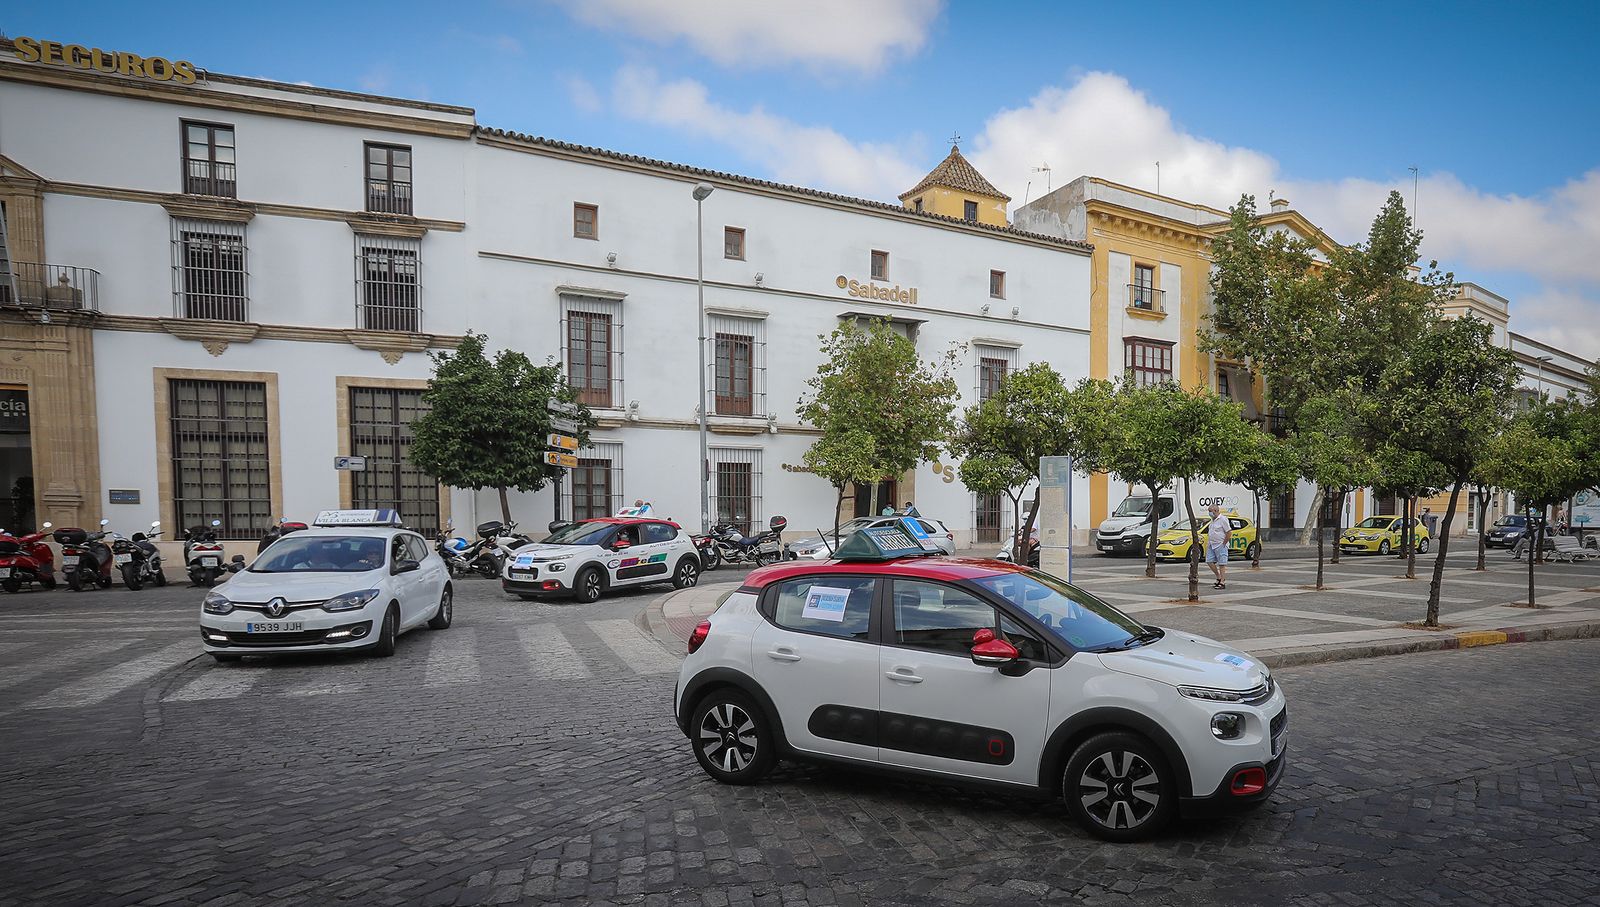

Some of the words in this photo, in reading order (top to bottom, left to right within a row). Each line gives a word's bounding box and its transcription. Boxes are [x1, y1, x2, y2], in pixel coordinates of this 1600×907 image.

[14, 36, 197, 85] SEGUROS
[848, 279, 918, 304] Sabadell
[942, 465, 954, 483] S
[650, 540, 686, 548] AUTOESCUELA
[872, 534, 919, 551] GABRIEL
[254, 623, 280, 631] 9539
[284, 622, 302, 631] JJH
